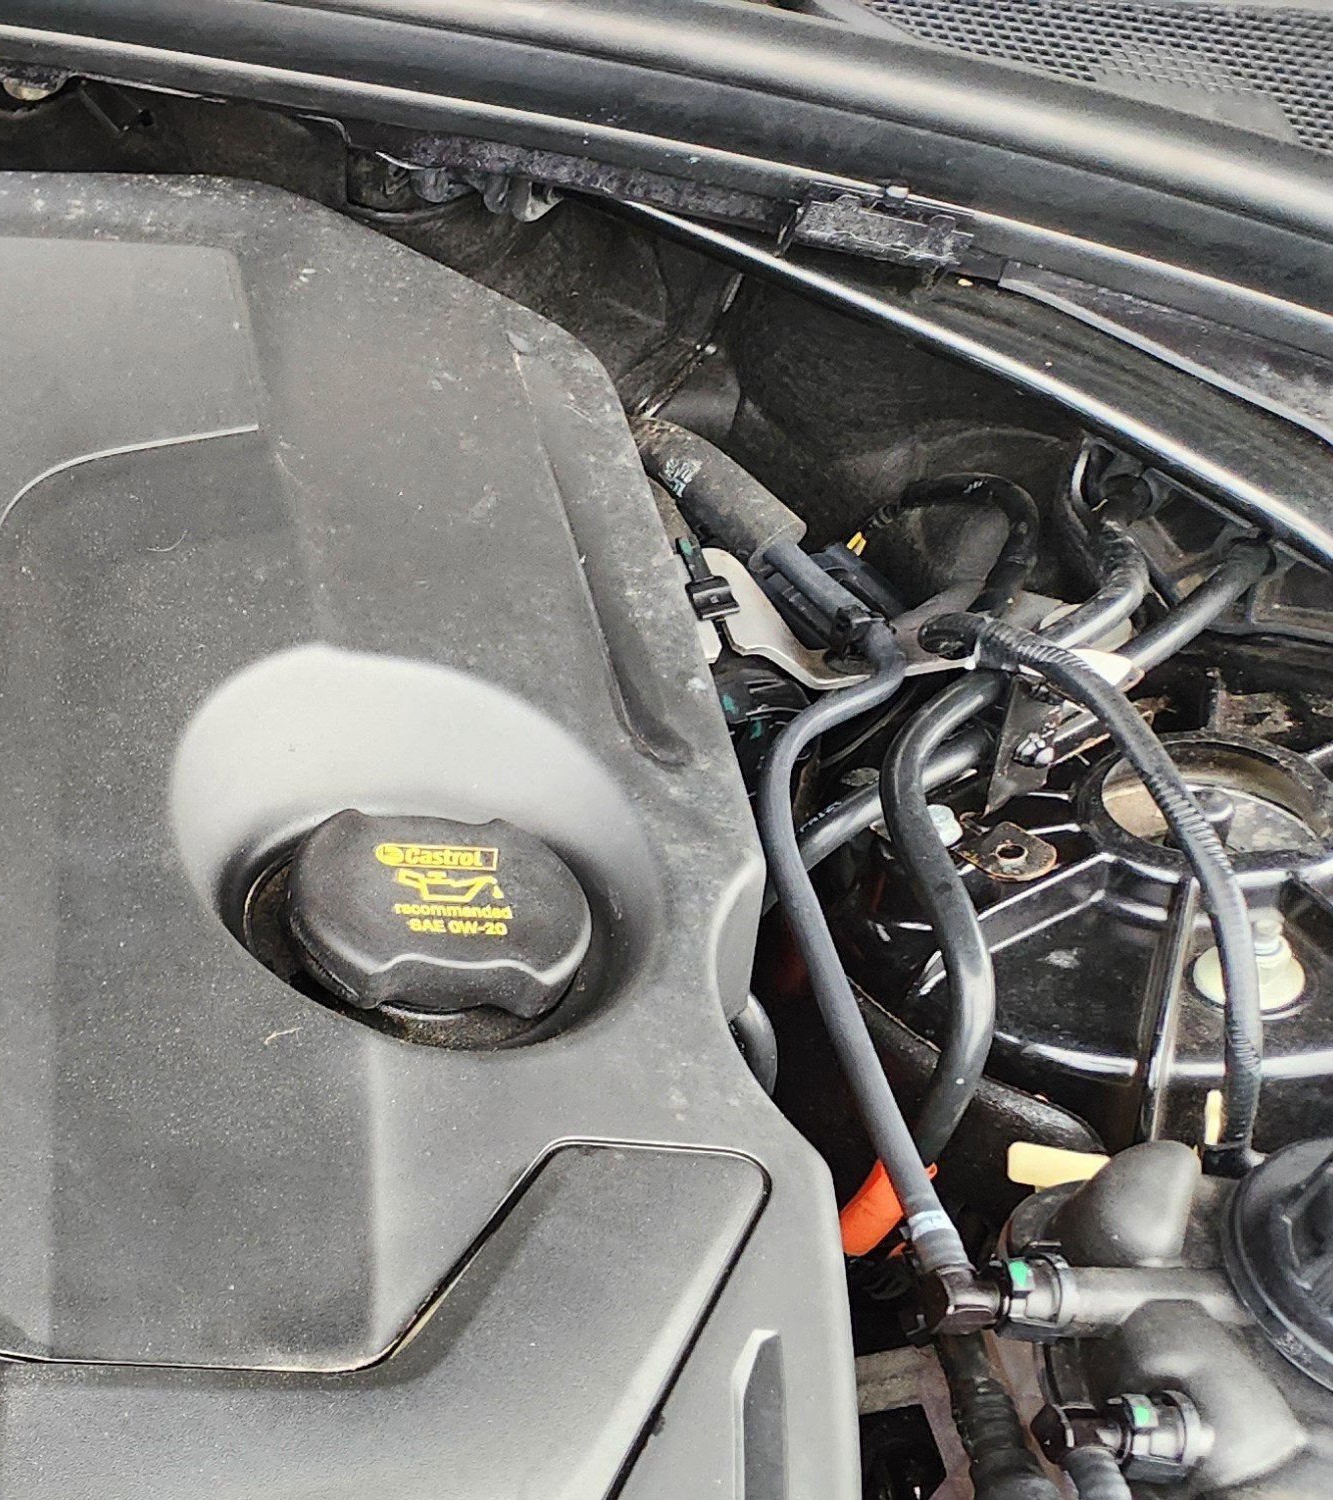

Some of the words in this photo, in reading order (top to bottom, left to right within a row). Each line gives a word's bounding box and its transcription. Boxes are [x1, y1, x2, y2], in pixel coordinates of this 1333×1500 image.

[404, 847, 483, 867] Castrol
[394, 903, 514, 919] recommended
[407, 918, 447, 933] SAE
[448, 920, 508, 936] 0W-20
